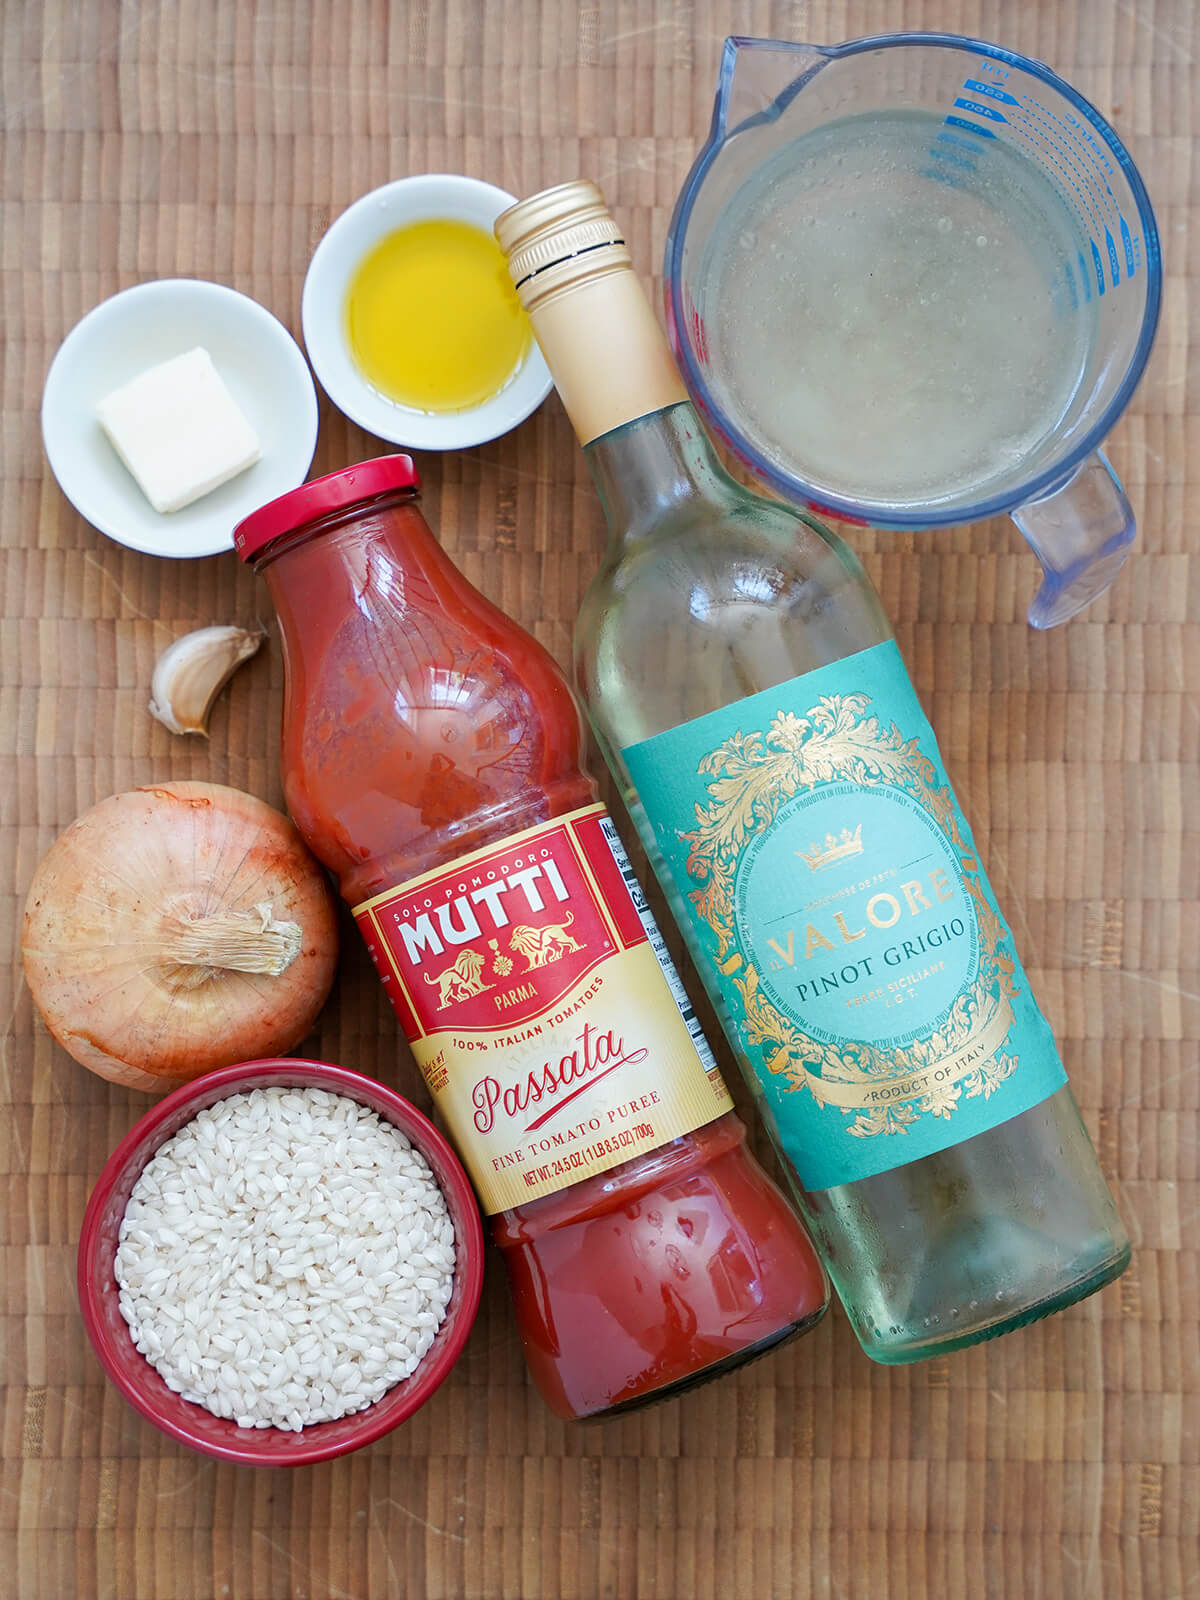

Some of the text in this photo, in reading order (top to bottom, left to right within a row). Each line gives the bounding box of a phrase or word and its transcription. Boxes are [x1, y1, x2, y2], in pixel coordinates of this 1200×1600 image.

[393, 899, 432, 922] SOLO
[397, 858, 571, 966] MUTTI
[766, 868, 954, 967] VALORE
[494, 982, 538, 1012] PARMA
[795, 918, 965, 1002] PINOT GRIGIO
[452, 976, 604, 1051] 100% ITALIAN TOMATOES
[844, 987, 885, 1009] TERRE
[472, 1023, 632, 1133] Passata
[934, 1065, 952, 1081] OF
[955, 1044, 986, 1070] ITALY
[491, 1150, 526, 1171] FINE
[528, 1118, 601, 1156] TOMATO
[607, 1091, 661, 1123] PUREE
[523, 1170, 541, 1187] NET
[538, 1165, 554, 1183] WT.
[551, 1156, 571, 1176] 24.5
[570, 1152, 581, 1168] OZ
[592, 1141, 607, 1160] LB
[606, 1137, 620, 1154] 8.5
[633, 1122, 655, 1141] 700g
